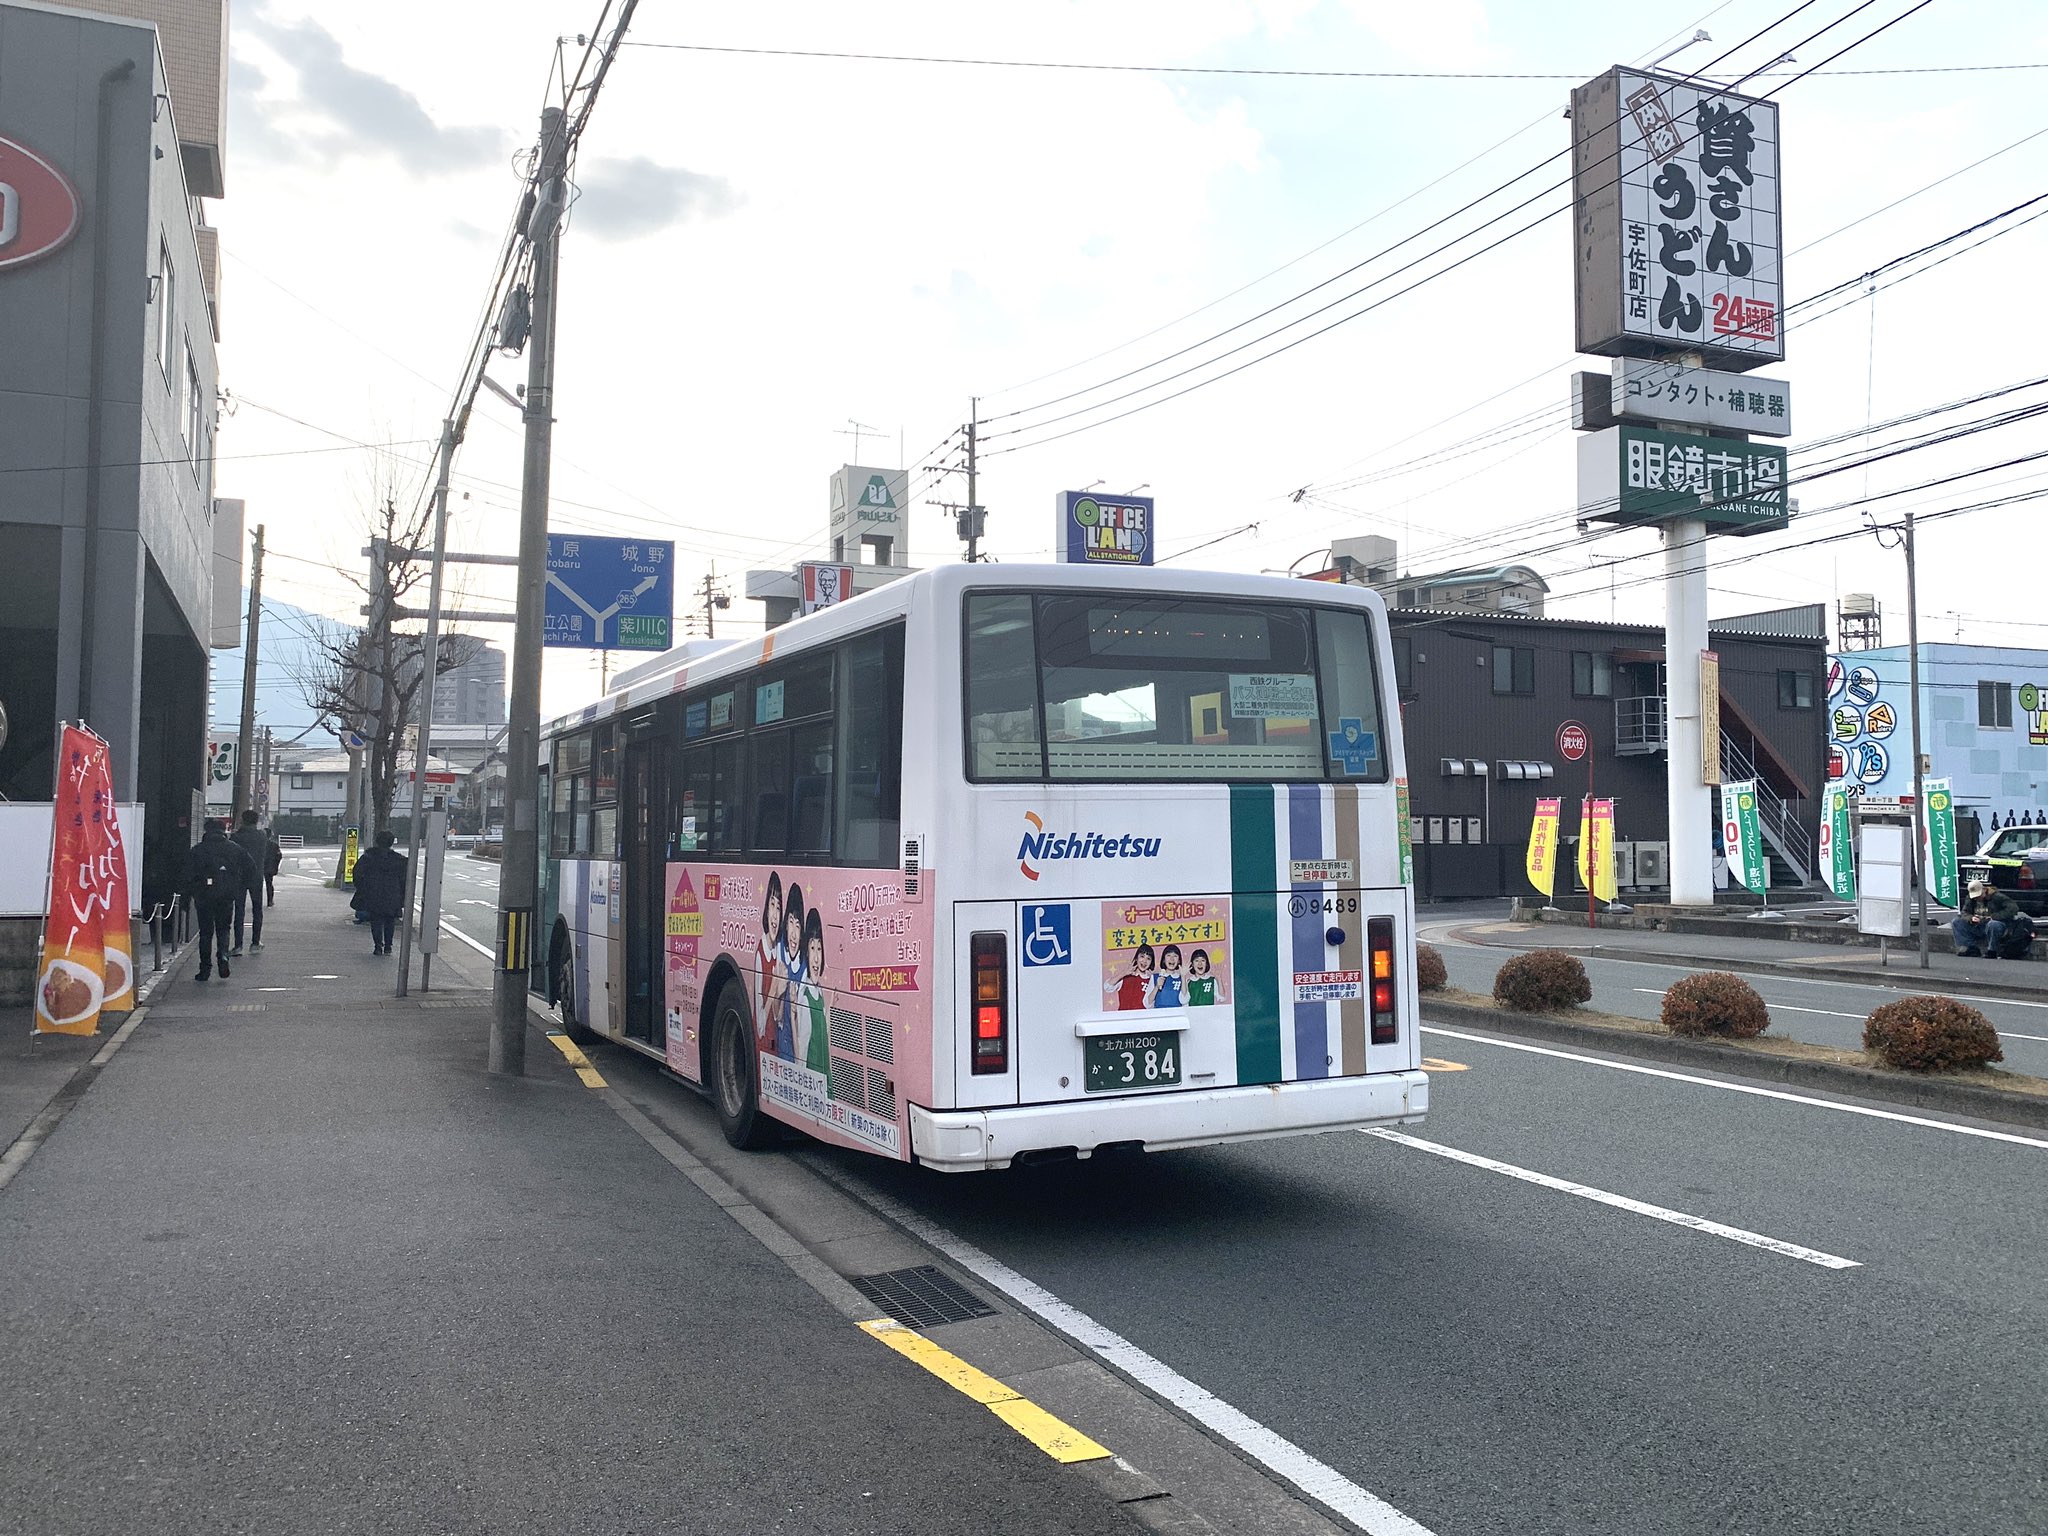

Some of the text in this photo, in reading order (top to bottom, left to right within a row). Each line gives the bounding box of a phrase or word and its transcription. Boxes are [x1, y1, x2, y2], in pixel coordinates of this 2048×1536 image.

[1696, 99, 1755, 278] 資さん
[1653, 162, 1703, 333] うどん
[1628, 224, 1647, 320] 宇佐町店
[1712, 292, 1775, 336] 24時間
[1627, 378, 1785, 418] コンタクト・補聴器
[1627, 439, 1781, 504] 眼鏡市場
[1750, 505, 1781, 517] ICHIBA
[1087, 526, 1144, 554] LAND
[621, 544, 665, 564] 城野
[631, 563, 656, 574] Jono
[619, 594, 635, 604] 265
[562, 632, 582, 642] Park
[1249, 676, 1295, 686] 西鉄グループ
[1563, 736, 1584, 750] 消火栓
[1016, 832, 1162, 861] Nishitetsu
[1124, 901, 1205, 924] オール電化に
[1309, 898, 1358, 915] 9489
[1112, 922, 1220, 948] 変えるなら今です!
[896, 939, 922, 962] 当たる!
[1104, 1036, 1157, 1051] 北九州200
